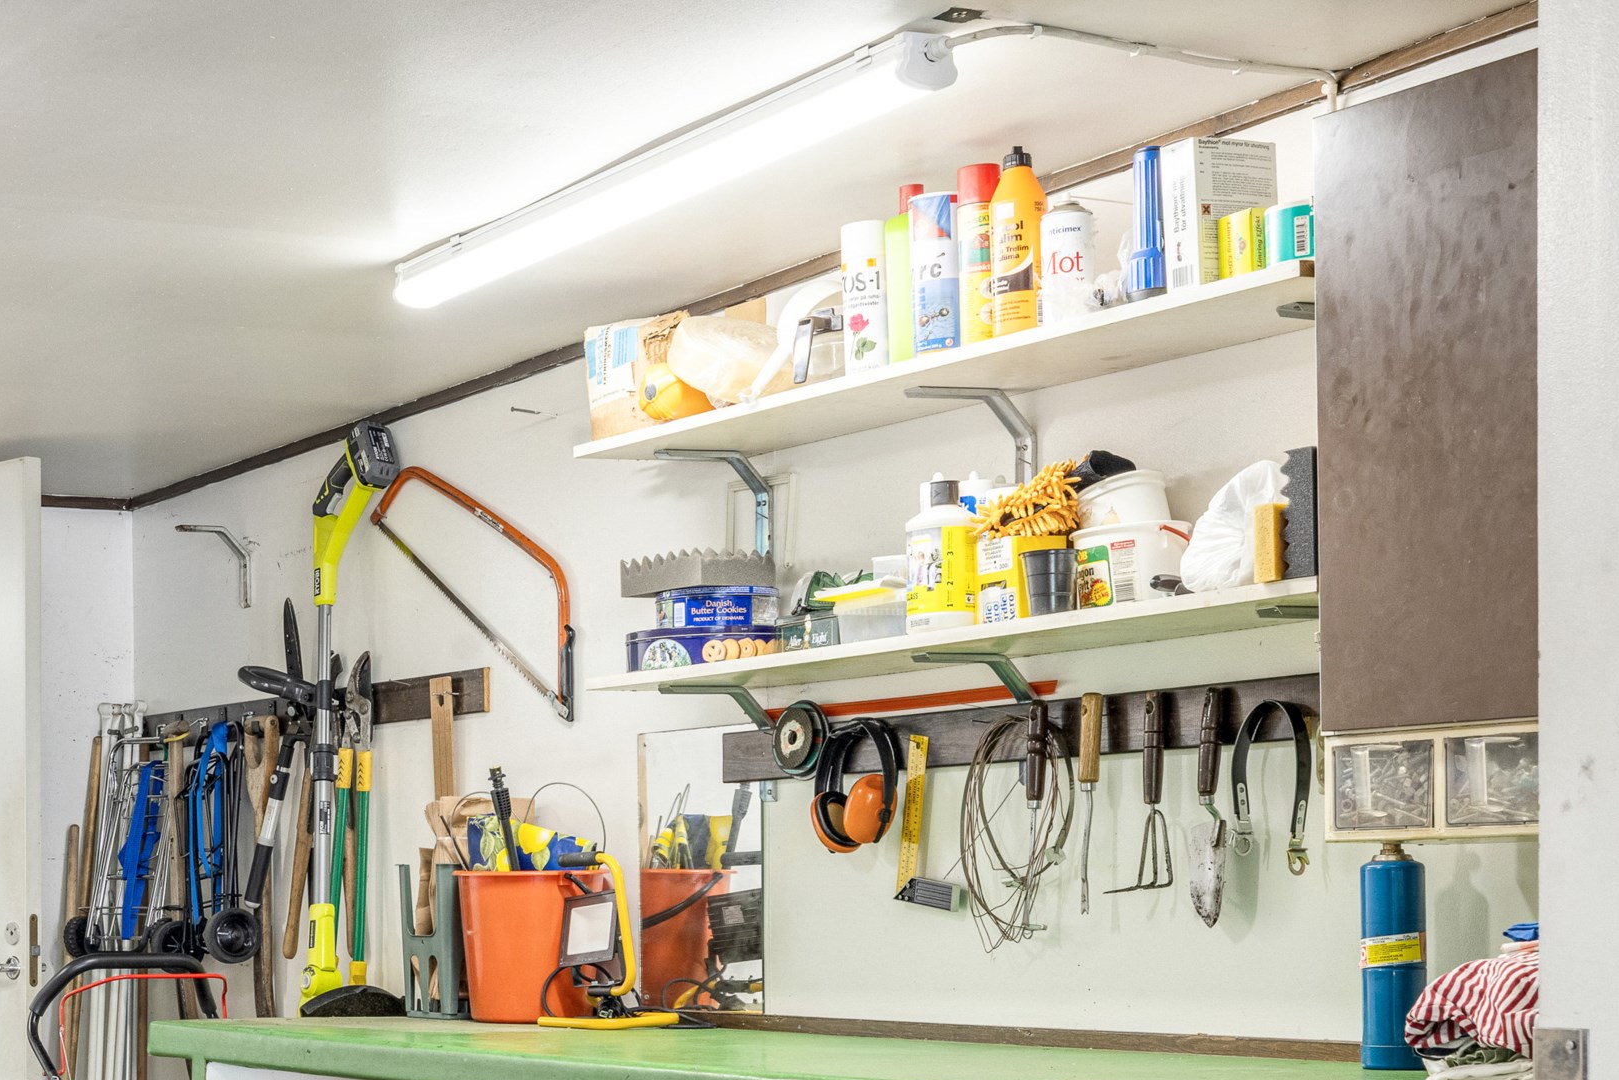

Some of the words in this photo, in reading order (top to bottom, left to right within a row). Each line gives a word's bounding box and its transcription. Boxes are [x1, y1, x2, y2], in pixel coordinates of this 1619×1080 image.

[1049, 226, 1082, 235] nticimex
[1042, 249, 1084, 275] Mot
[842, 270, 881, 293] OS-1
[691, 606, 715, 615] Butter
[716, 605, 747, 614] Cookies
[705, 600, 733, 608] Danish
[1000, 596, 1009, 620] rdic
